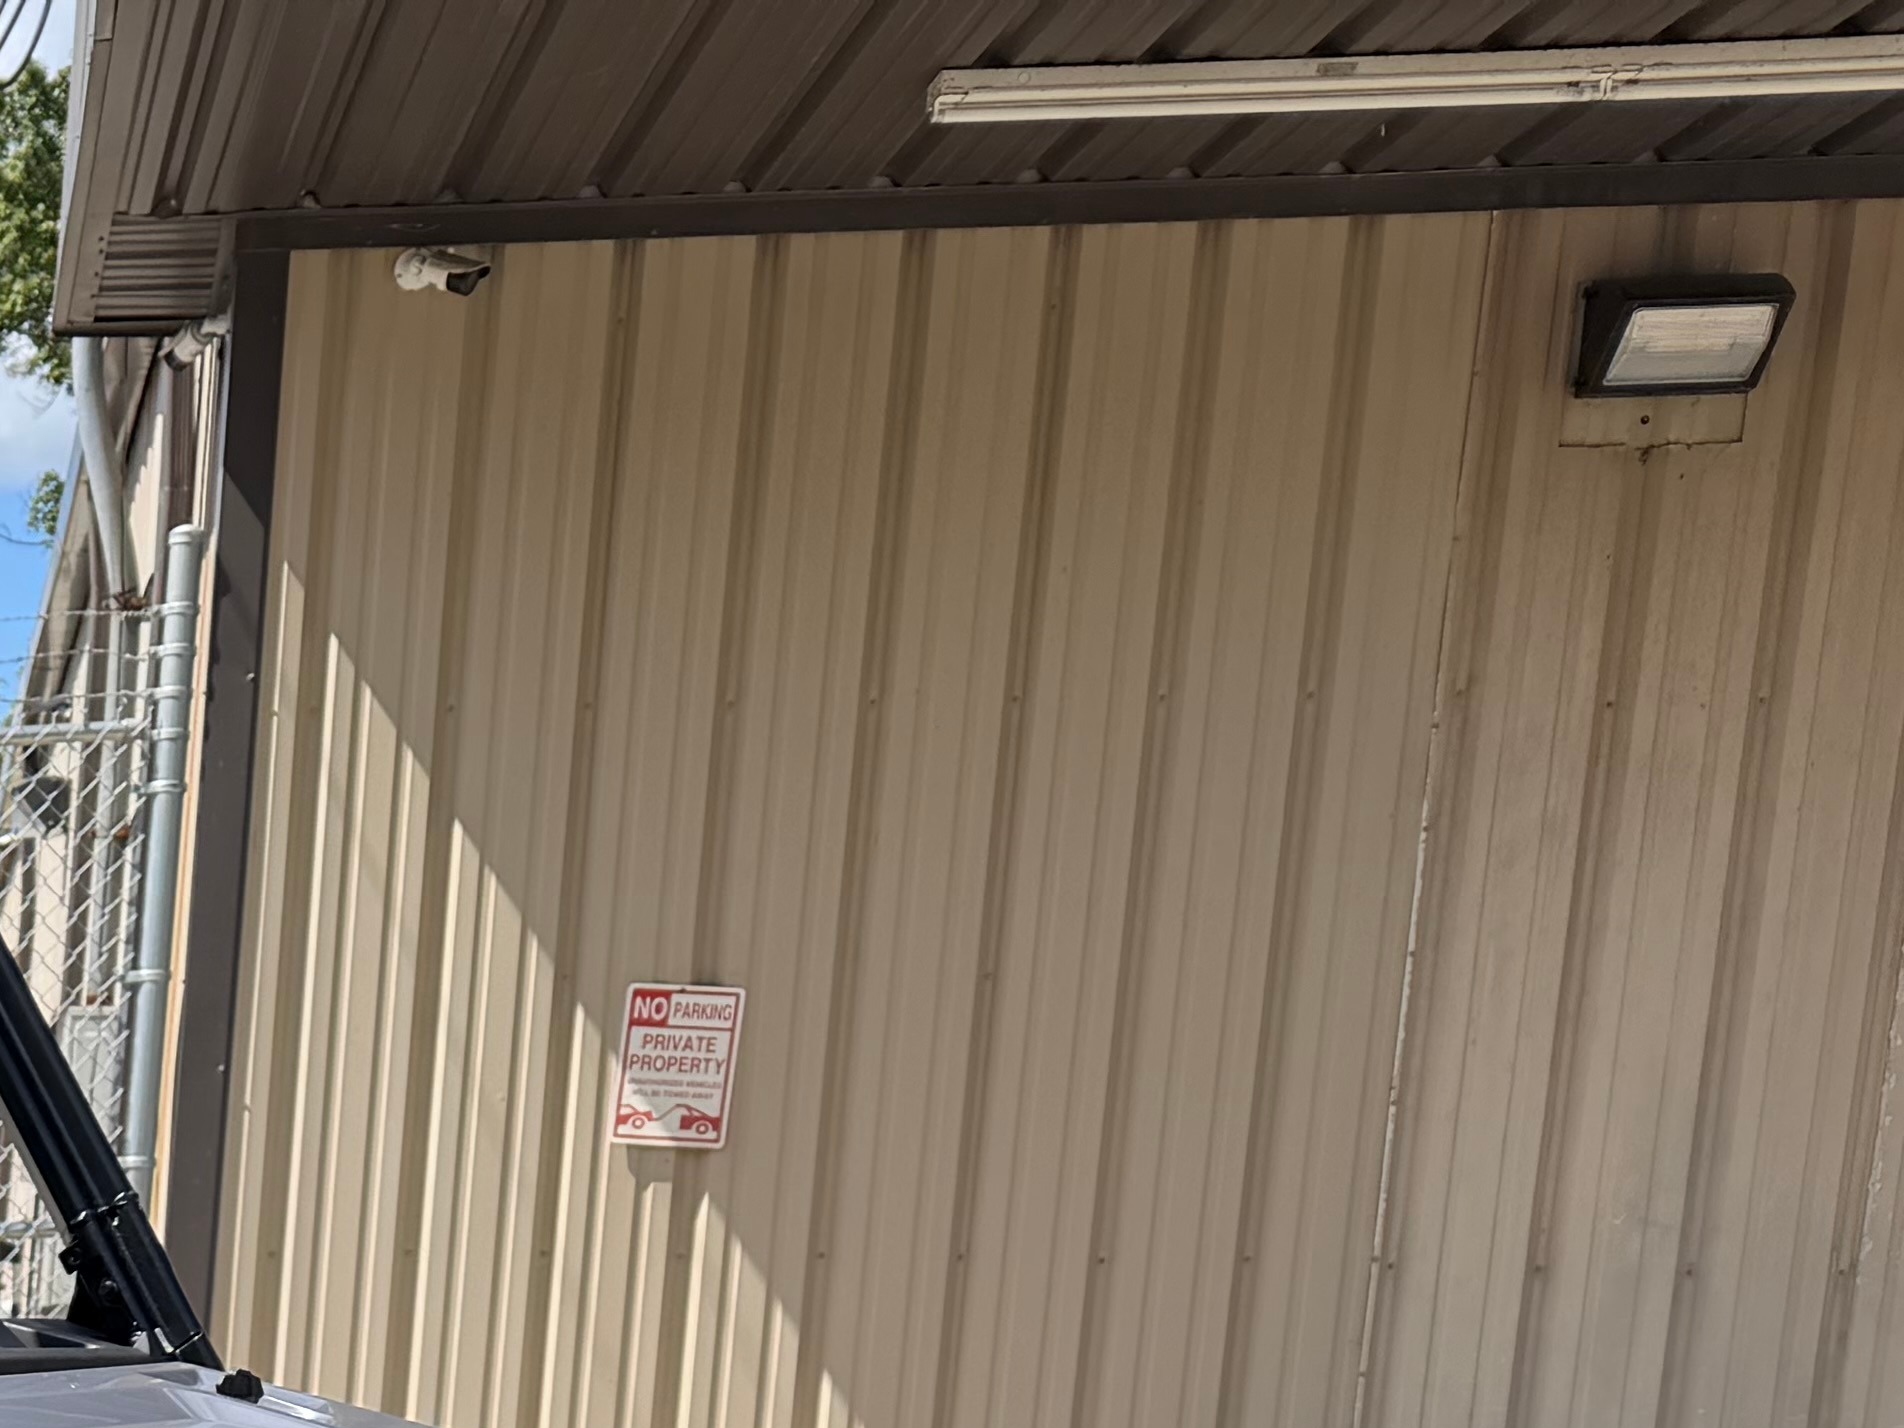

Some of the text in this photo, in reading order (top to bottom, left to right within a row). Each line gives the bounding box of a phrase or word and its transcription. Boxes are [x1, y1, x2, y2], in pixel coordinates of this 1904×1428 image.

[634, 996, 732, 1020] NO PARKING
[641, 1033, 718, 1053] PRIVATE
[629, 1053, 726, 1075] PROPERTY
